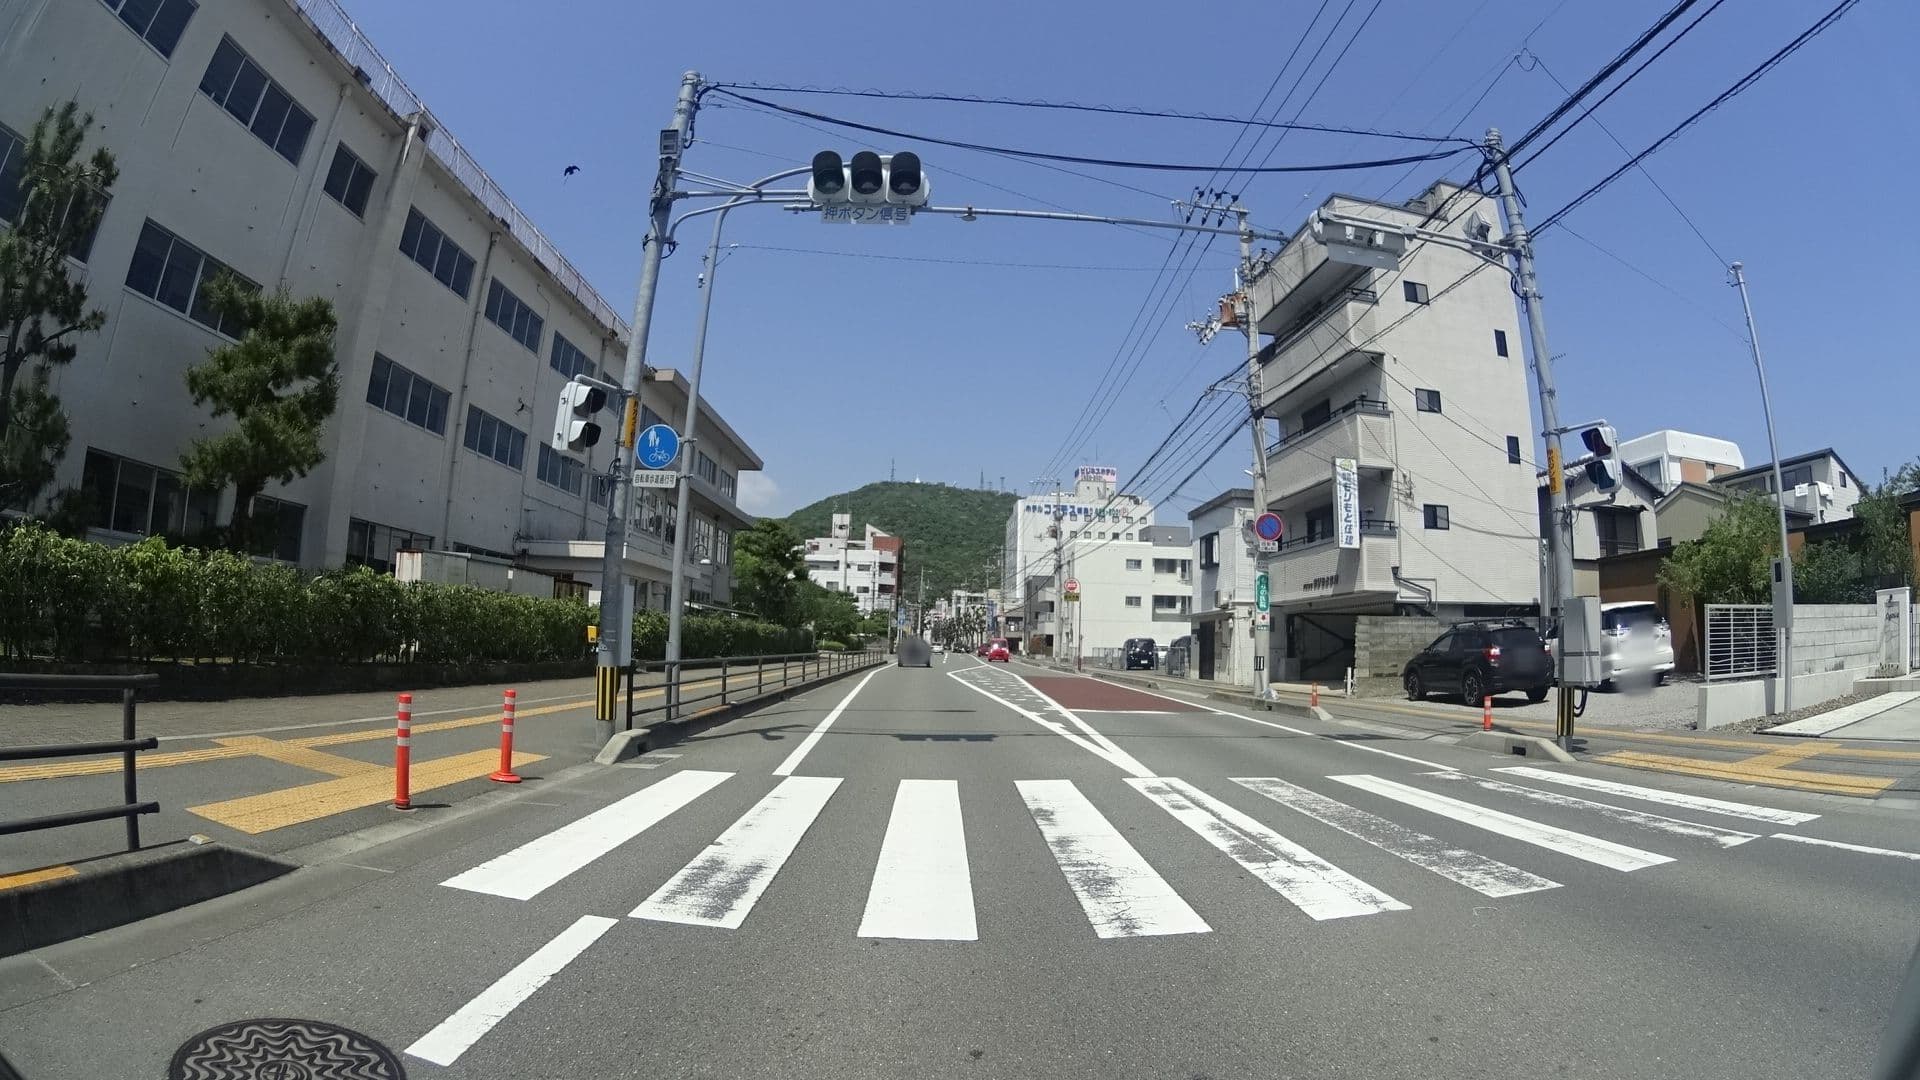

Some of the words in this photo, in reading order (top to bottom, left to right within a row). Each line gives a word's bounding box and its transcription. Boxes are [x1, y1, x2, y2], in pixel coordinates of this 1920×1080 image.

[824, 207, 908, 221] 押ボタン信号
